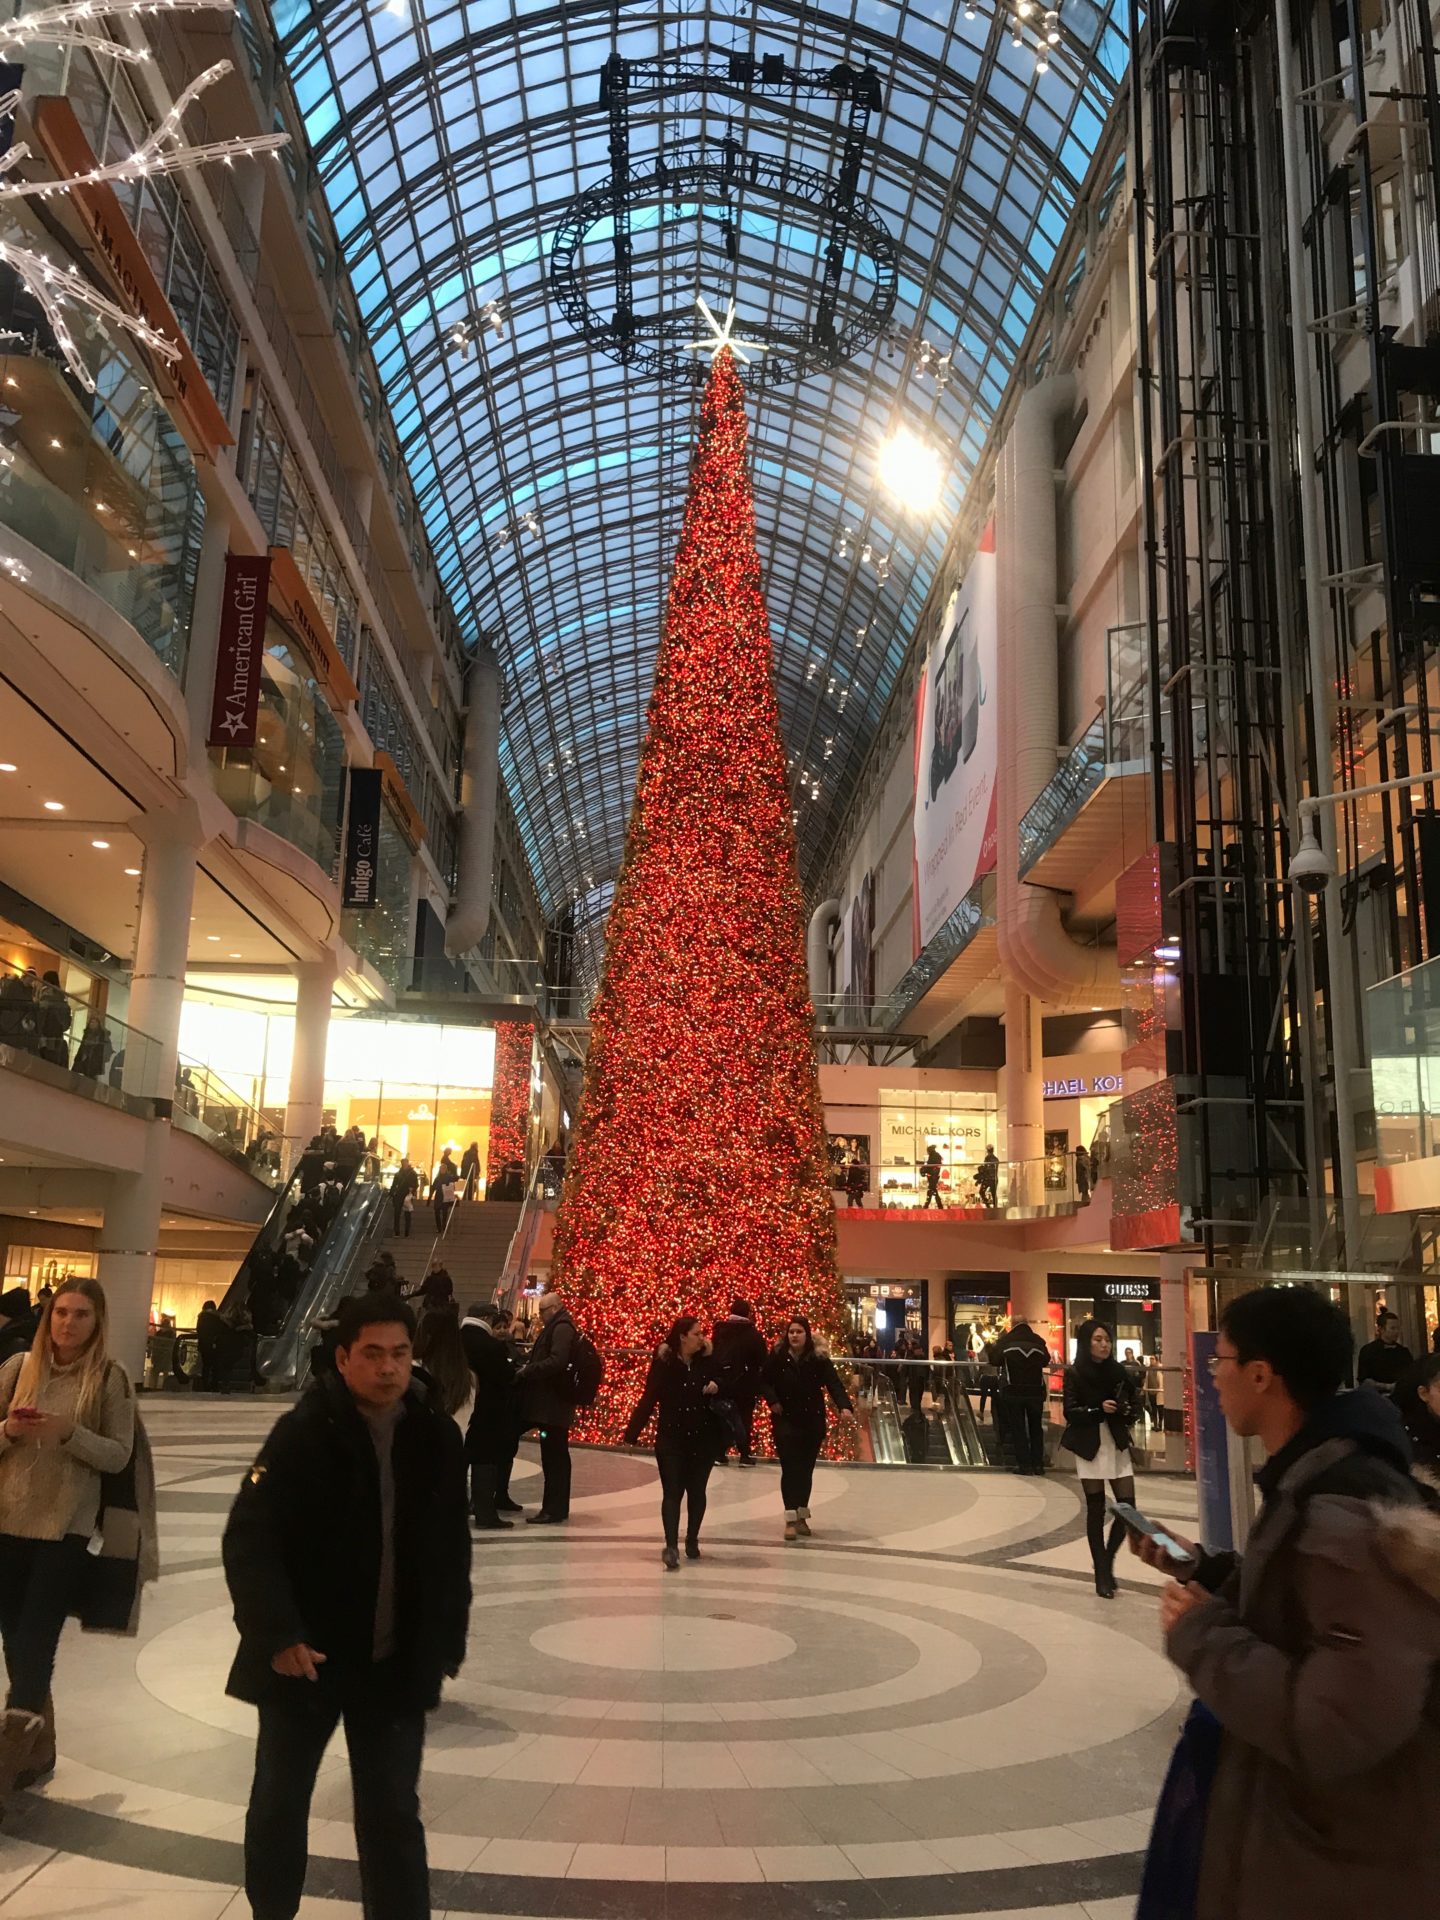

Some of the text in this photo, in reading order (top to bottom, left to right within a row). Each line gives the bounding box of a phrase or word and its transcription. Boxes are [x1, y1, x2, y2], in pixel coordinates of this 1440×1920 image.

[349, 823, 374, 903] Indigo Café
[892, 1125, 981, 1138] MICHAEL KORS
[1105, 1284, 1149, 1296] GUESS
